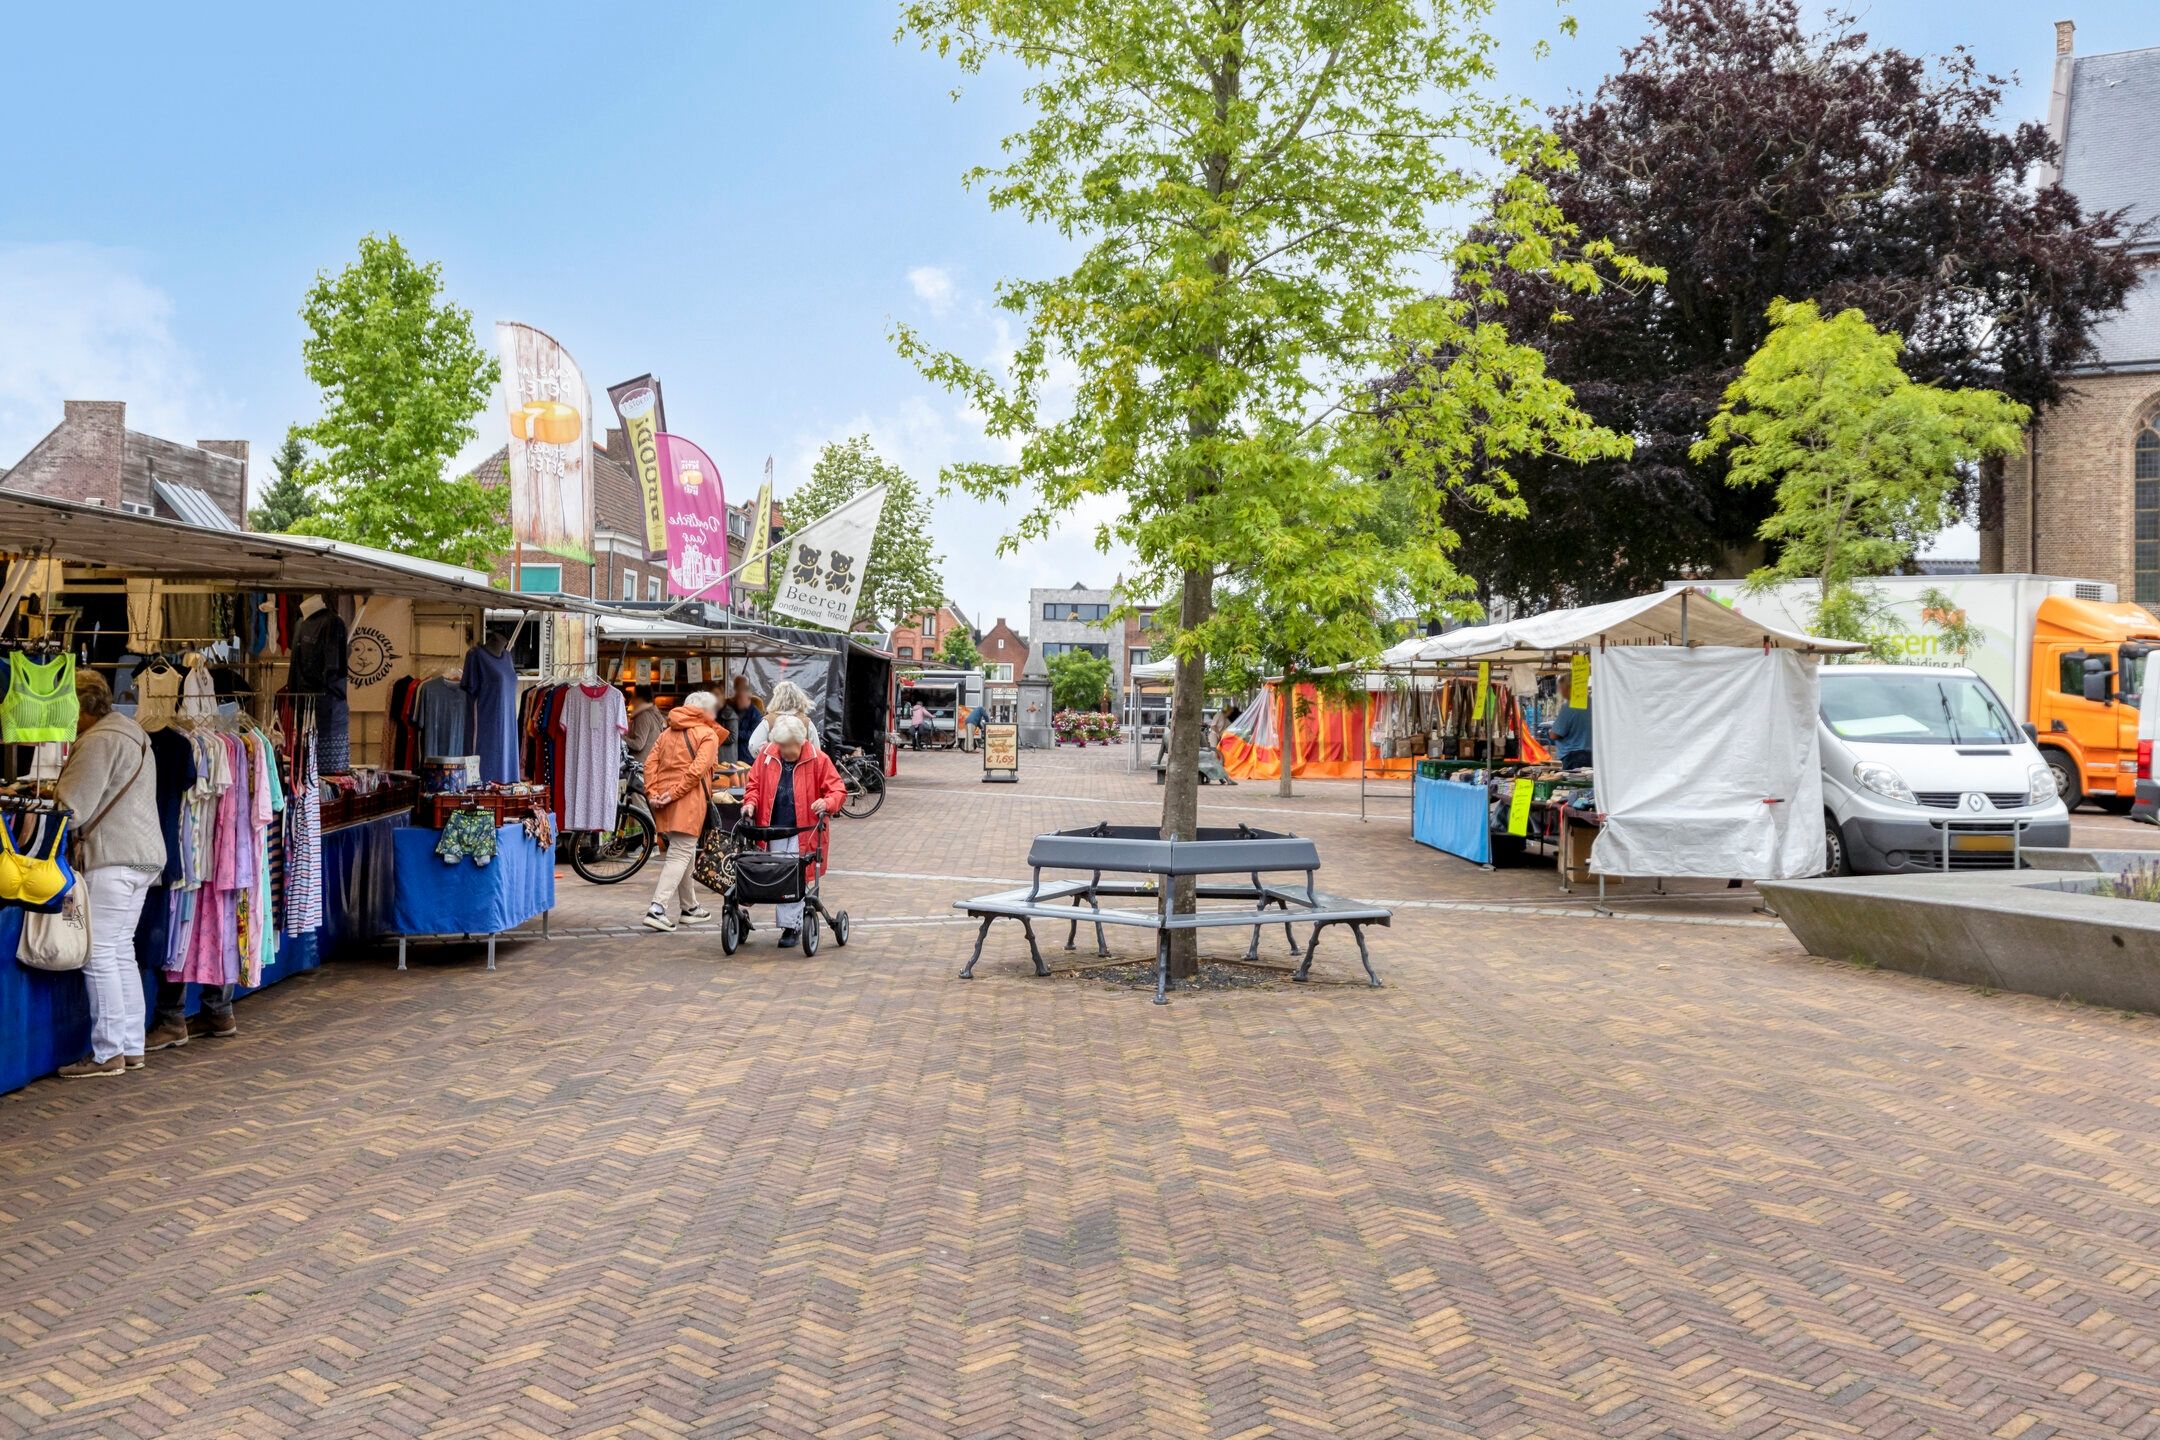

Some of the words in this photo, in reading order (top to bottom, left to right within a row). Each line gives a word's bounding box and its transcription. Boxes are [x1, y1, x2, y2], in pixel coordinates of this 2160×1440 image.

[635, 417, 660, 522] BROOD!
[778, 602, 822, 618] ondergoed
[827, 610, 848, 622] tricot
[786, 585, 847, 613] Beeren
